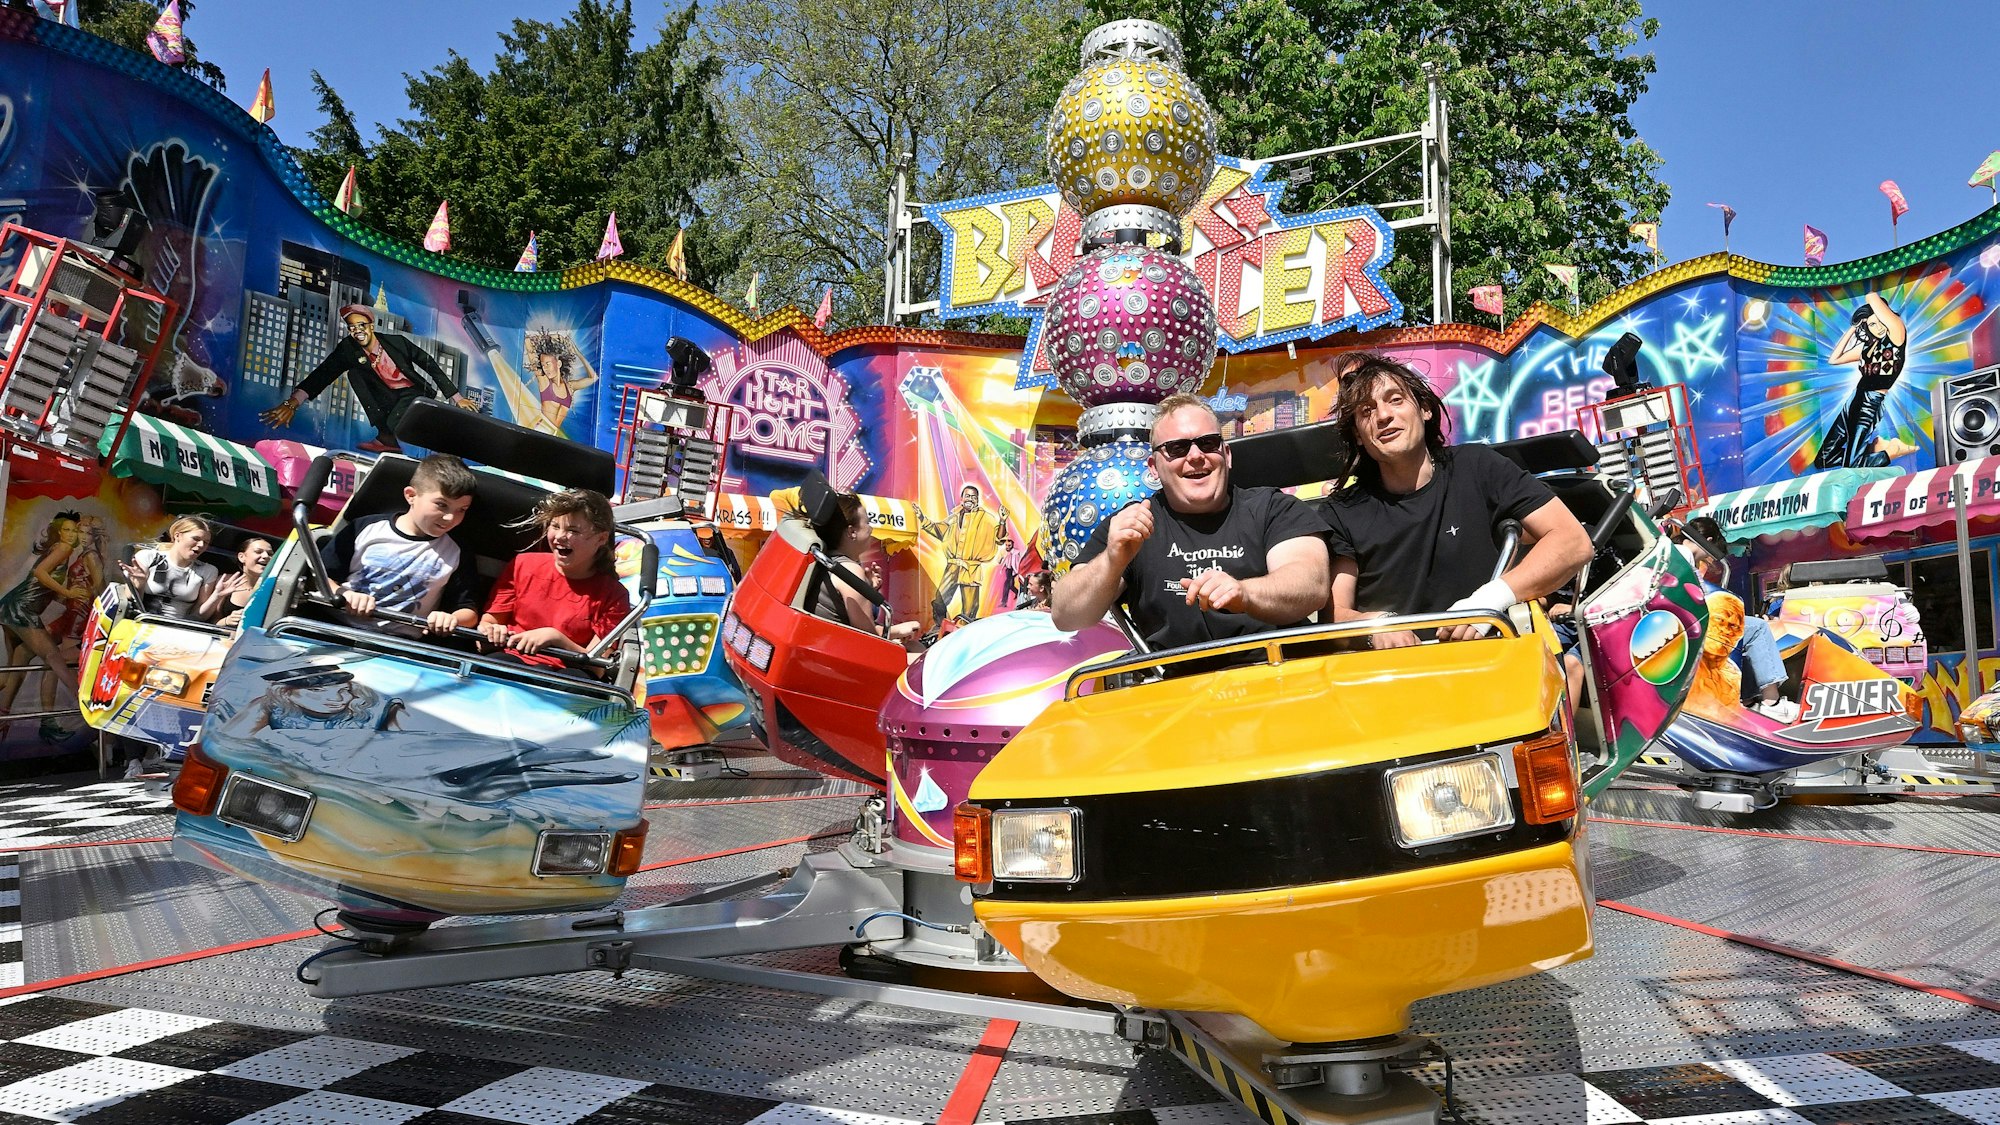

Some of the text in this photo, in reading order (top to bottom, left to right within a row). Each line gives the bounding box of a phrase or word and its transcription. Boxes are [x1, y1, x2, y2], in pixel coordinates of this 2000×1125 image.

[746, 382, 823, 420] LIGHT
[724, 404, 846, 453] DOME
[149, 439, 261, 488] NO RISK NO FUN
[716, 509, 752, 525] KRASS
[1741, 493, 1810, 523] GENERATION
[1870, 500, 1901, 518] TOP
[1910, 496, 1928, 510] OF
[1803, 680, 1905, 719] SILVER
